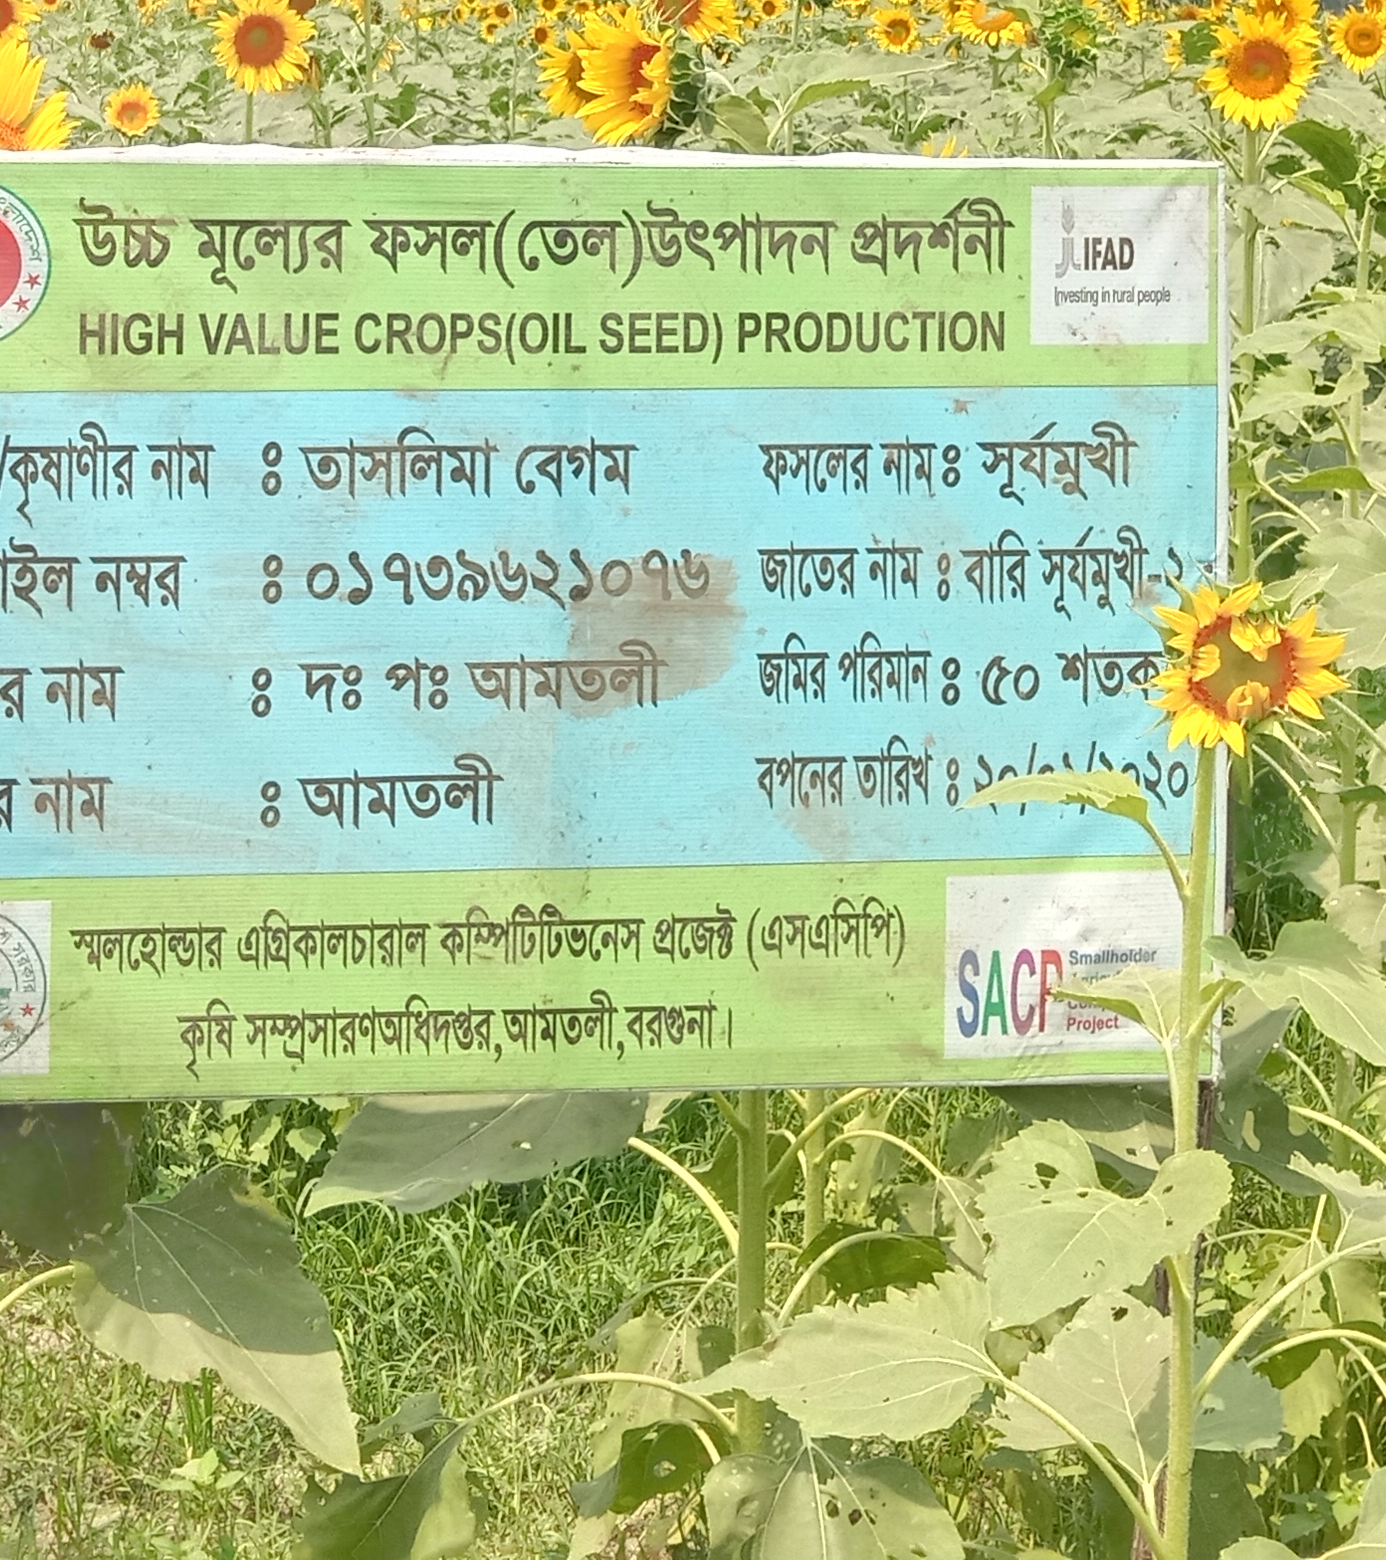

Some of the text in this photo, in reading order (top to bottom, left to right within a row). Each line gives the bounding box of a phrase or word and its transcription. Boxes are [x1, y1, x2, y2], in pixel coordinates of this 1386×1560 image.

[73, 197, 177, 269] উচ্চ
[190, 218, 351, 295] মূল্যের
[851, 198, 1015, 275] প্রদর্শনী
[1083, 236, 1136, 271] IFAD
[1054, 286, 1171, 308] Investing in rural people
[78, 310, 1006, 366] HIGH VALUE CROPS(OIL SEED) PRODUCTION
[146, 436, 216, 501] নাম
[298, 426, 500, 500] তাসলিমা
[515, 436, 639, 498] বেগম
[758, 441, 873, 496] ফসলের
[976, 420, 1140, 506] সূর্যমুখী
[89, 554, 188, 612] নম্বর
[306, 547, 711, 611] ০১৭৩৯৬২১০৭৬
[757, 540, 859, 602] জাতের
[865, 538, 924, 600] নাম
[960, 528, 1031, 604] বারি
[40, 657, 125, 724] নাম
[465, 638, 670, 713] আমতলী
[755, 631, 830, 705] জমির
[837, 630, 933, 705] পরিমান
[981, 654, 1041, 707] ৫০
[28, 768, 114, 834] নাম
[296, 751, 505, 831] আমতলী
[754, 749, 848, 810] বপনের
[853, 733, 934, 807] তারিখ
[69, 921, 228, 979] স্মলহোল্ডার
[237, 908, 431, 973] এগ্রিকালচারাল
[652, 901, 739, 964] প্রজেক্ট
[1068, 947, 1158, 966] Smallholder
[955, 947, 1065, 1039] SACP
[1065, 1014, 1120, 1034] Project
[176, 997, 239, 1082] কৃষি
